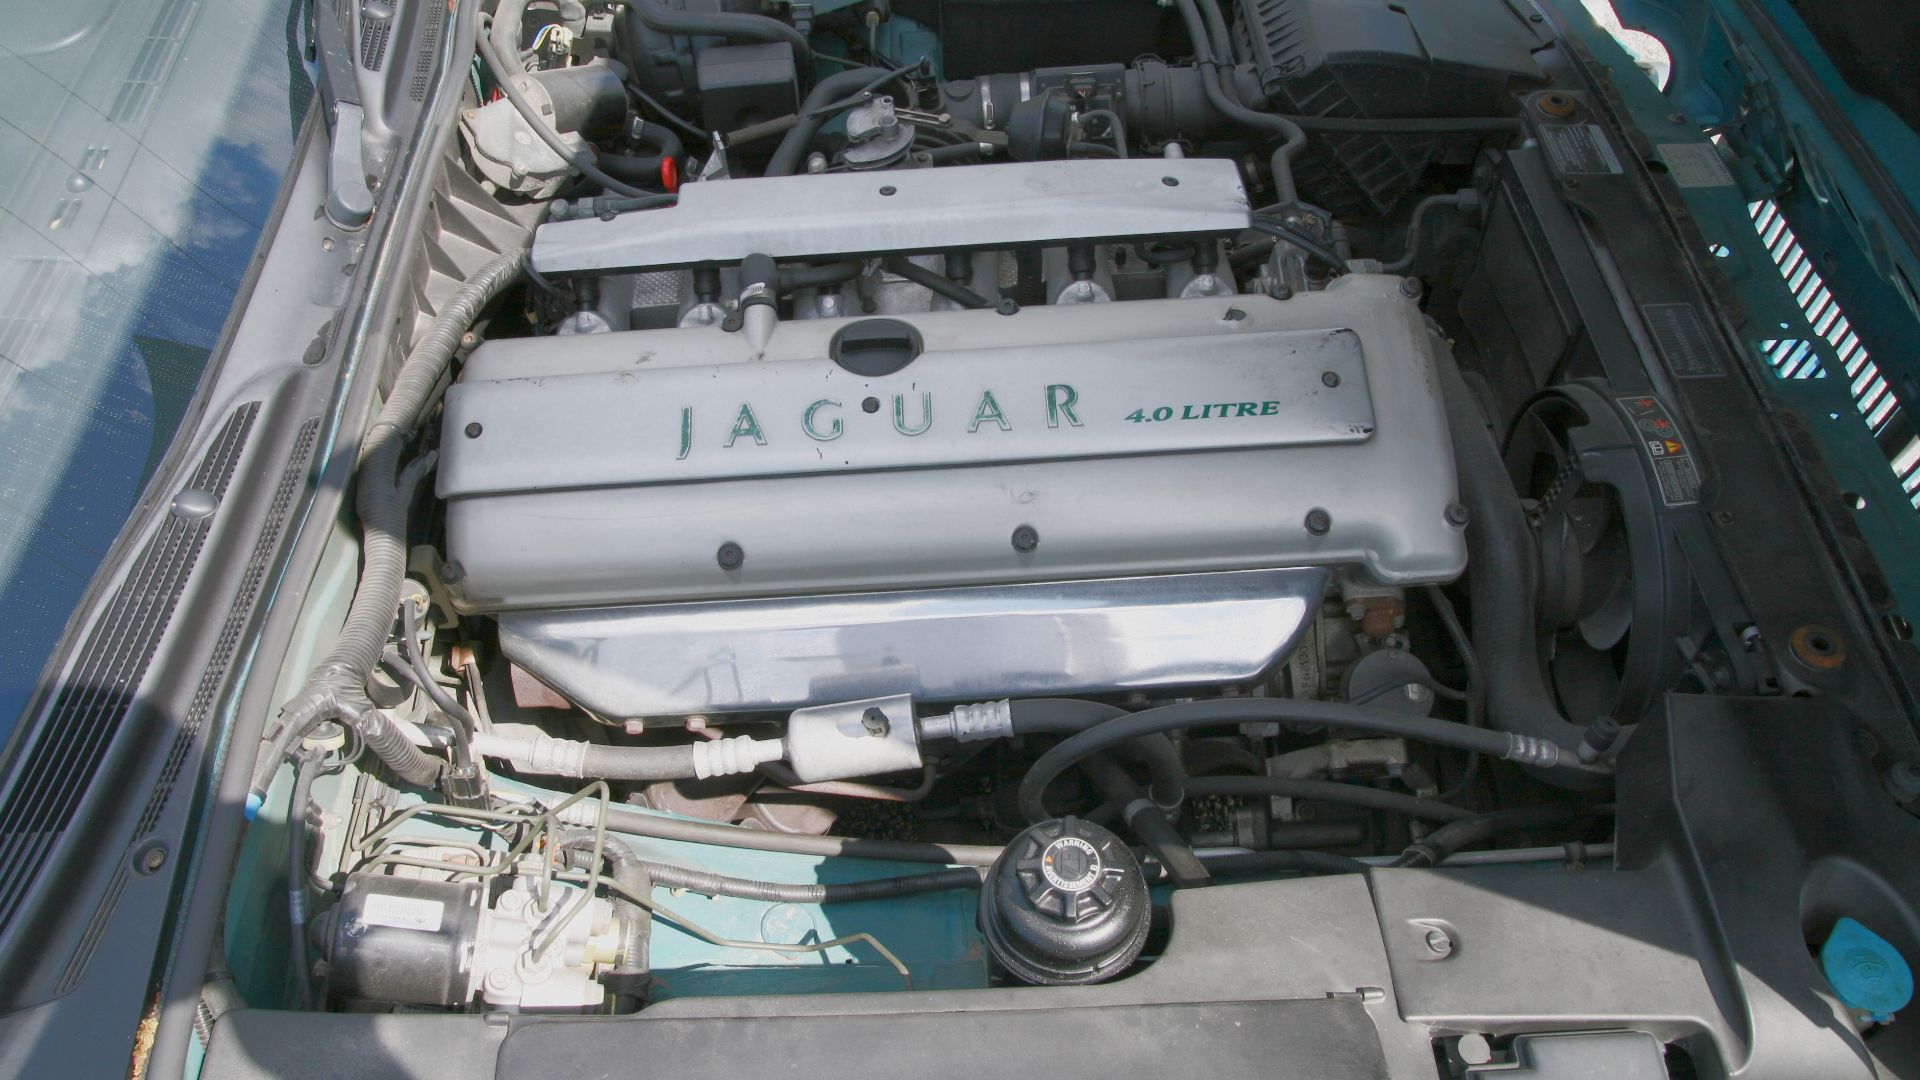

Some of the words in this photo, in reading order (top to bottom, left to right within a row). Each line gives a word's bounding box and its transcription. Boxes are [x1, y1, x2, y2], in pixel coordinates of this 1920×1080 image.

[676, 384, 1084, 460] JAGUAR
[1124, 406, 1174, 423] 4.0
[1180, 400, 1281, 420] LITRE
[1054, 839, 1093, 856] WARNING
